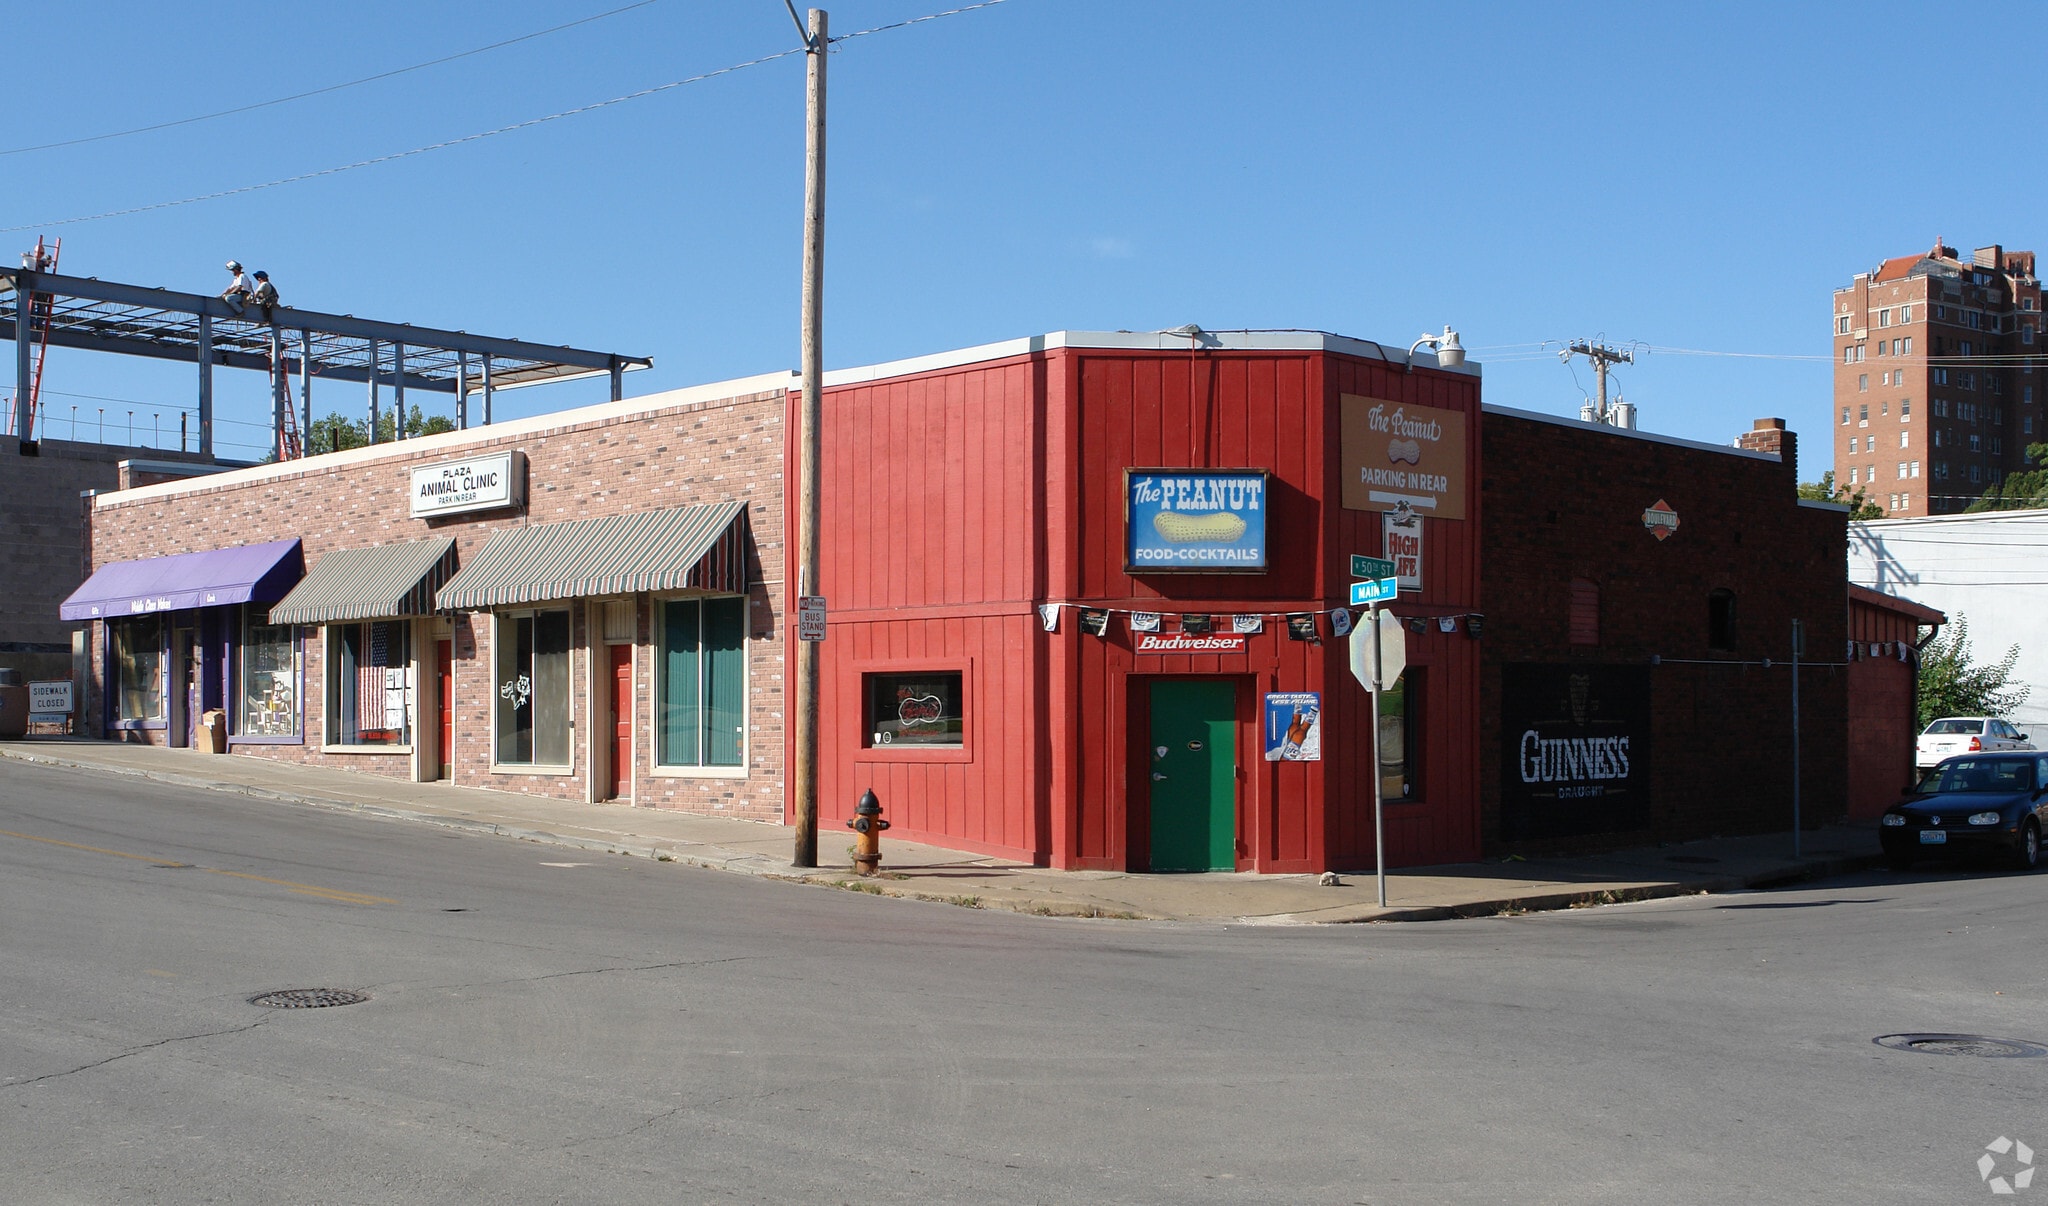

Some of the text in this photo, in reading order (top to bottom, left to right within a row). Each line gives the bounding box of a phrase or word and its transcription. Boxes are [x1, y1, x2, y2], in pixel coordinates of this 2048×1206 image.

[1368, 403, 1442, 442] The Peanut
[443, 466, 472, 479] PLAZA
[1361, 467, 1448, 492] PARKING IN REAR
[420, 472, 498, 498] ANIMAL CLINIC
[438, 496, 453, 505] PARK
[460, 492, 477, 502] REAR
[1133, 477, 1262, 510] The PEANUT
[1388, 532, 1419, 556] HIGH
[1135, 548, 1259, 560] FOOD-COCKTAILS
[1381, 564, 1391, 576] ST
[1358, 585, 1389, 600] MAIN ST
[805, 612, 820, 621] BUS
[801, 622, 824, 631] STAND
[1138, 635, 1244, 650] Budweiser
[33, 687, 69, 696] SIDEWALK
[37, 699, 65, 708] CLOSED
[1520, 729, 1630, 783] GUINNESS
[1558, 785, 1604, 799] DRAUGHT
